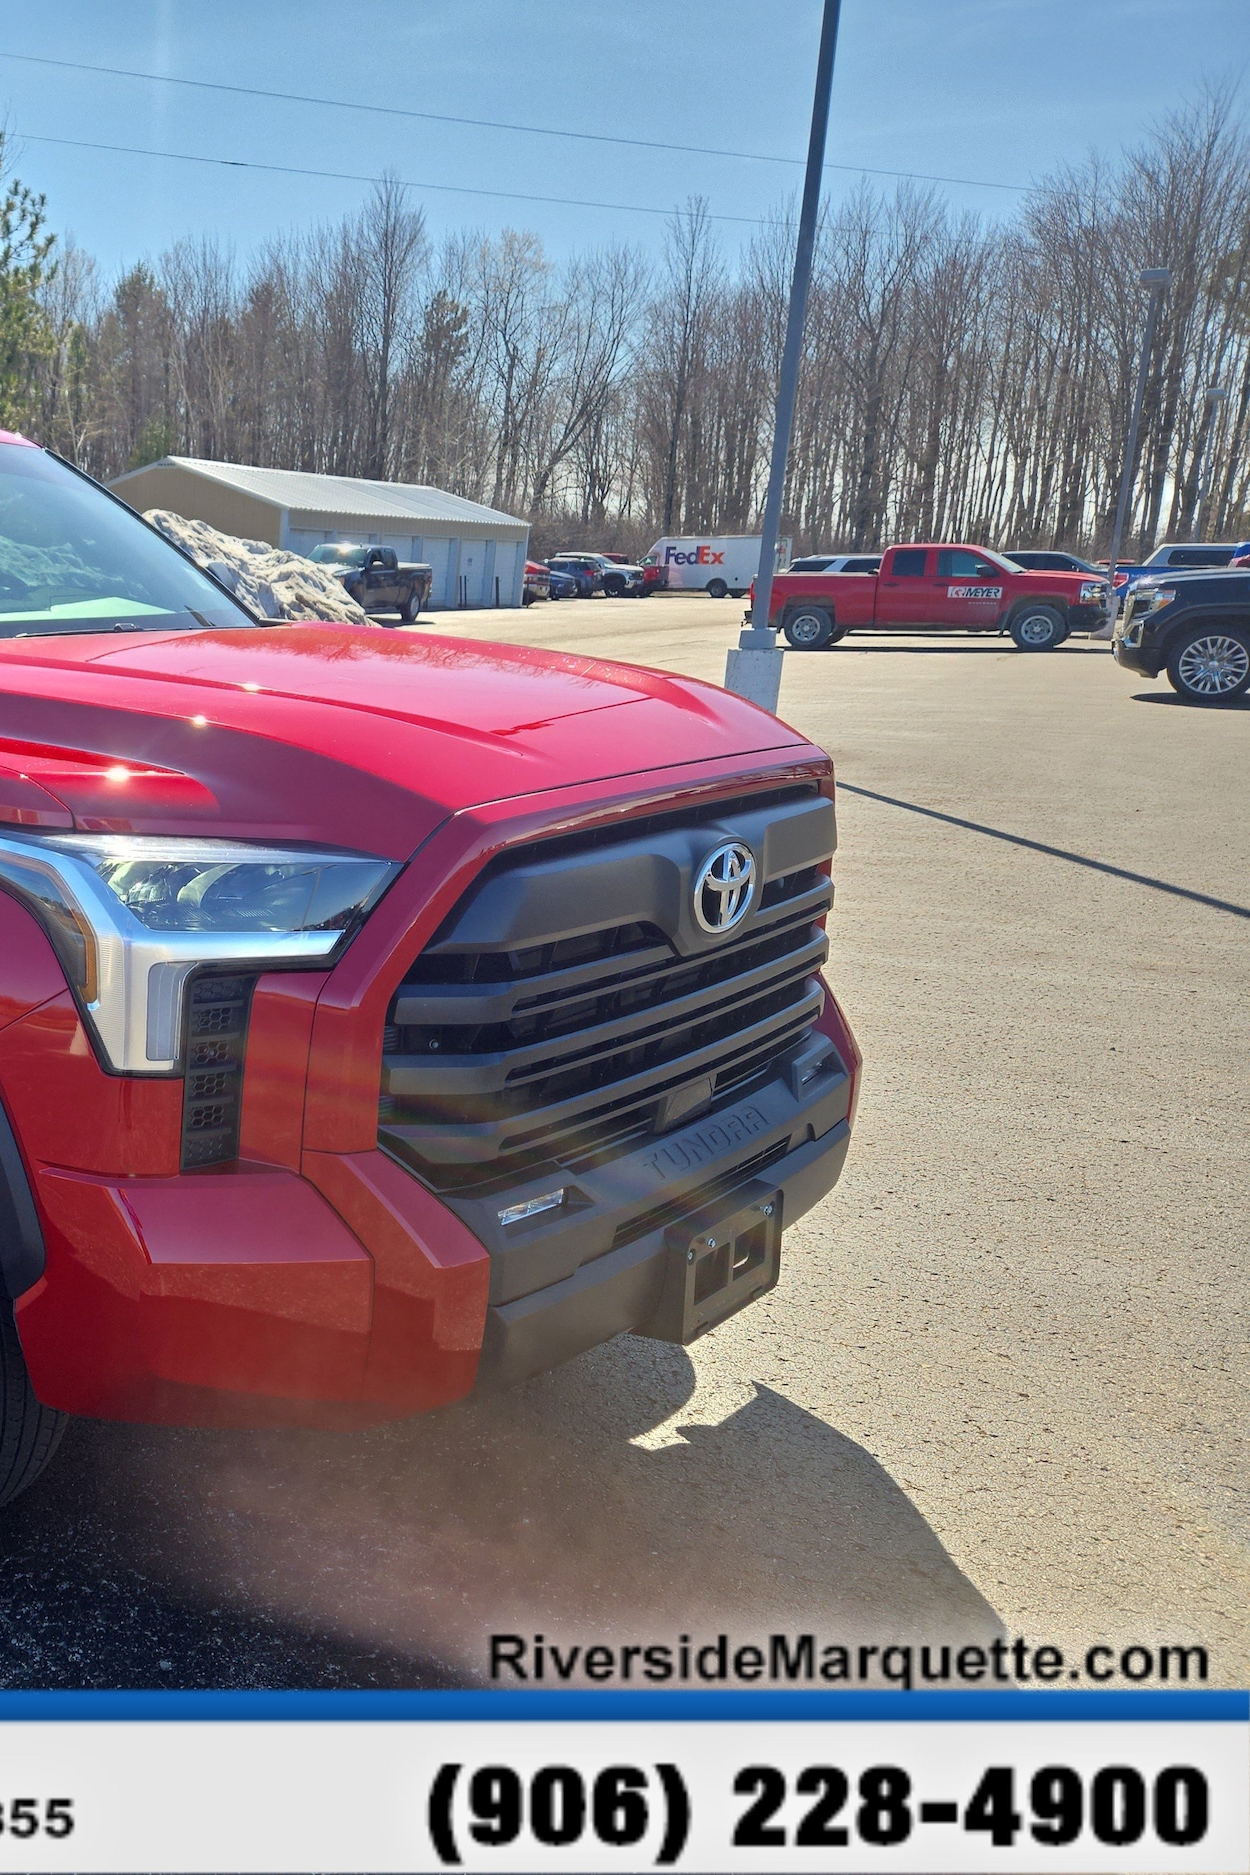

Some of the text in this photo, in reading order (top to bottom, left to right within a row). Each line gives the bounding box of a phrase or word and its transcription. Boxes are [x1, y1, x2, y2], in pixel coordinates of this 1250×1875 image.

[665, 545, 725, 565] FedEx
[965, 587, 1000, 598] MEYER
[642, 1105, 771, 1180] TUNDRA
